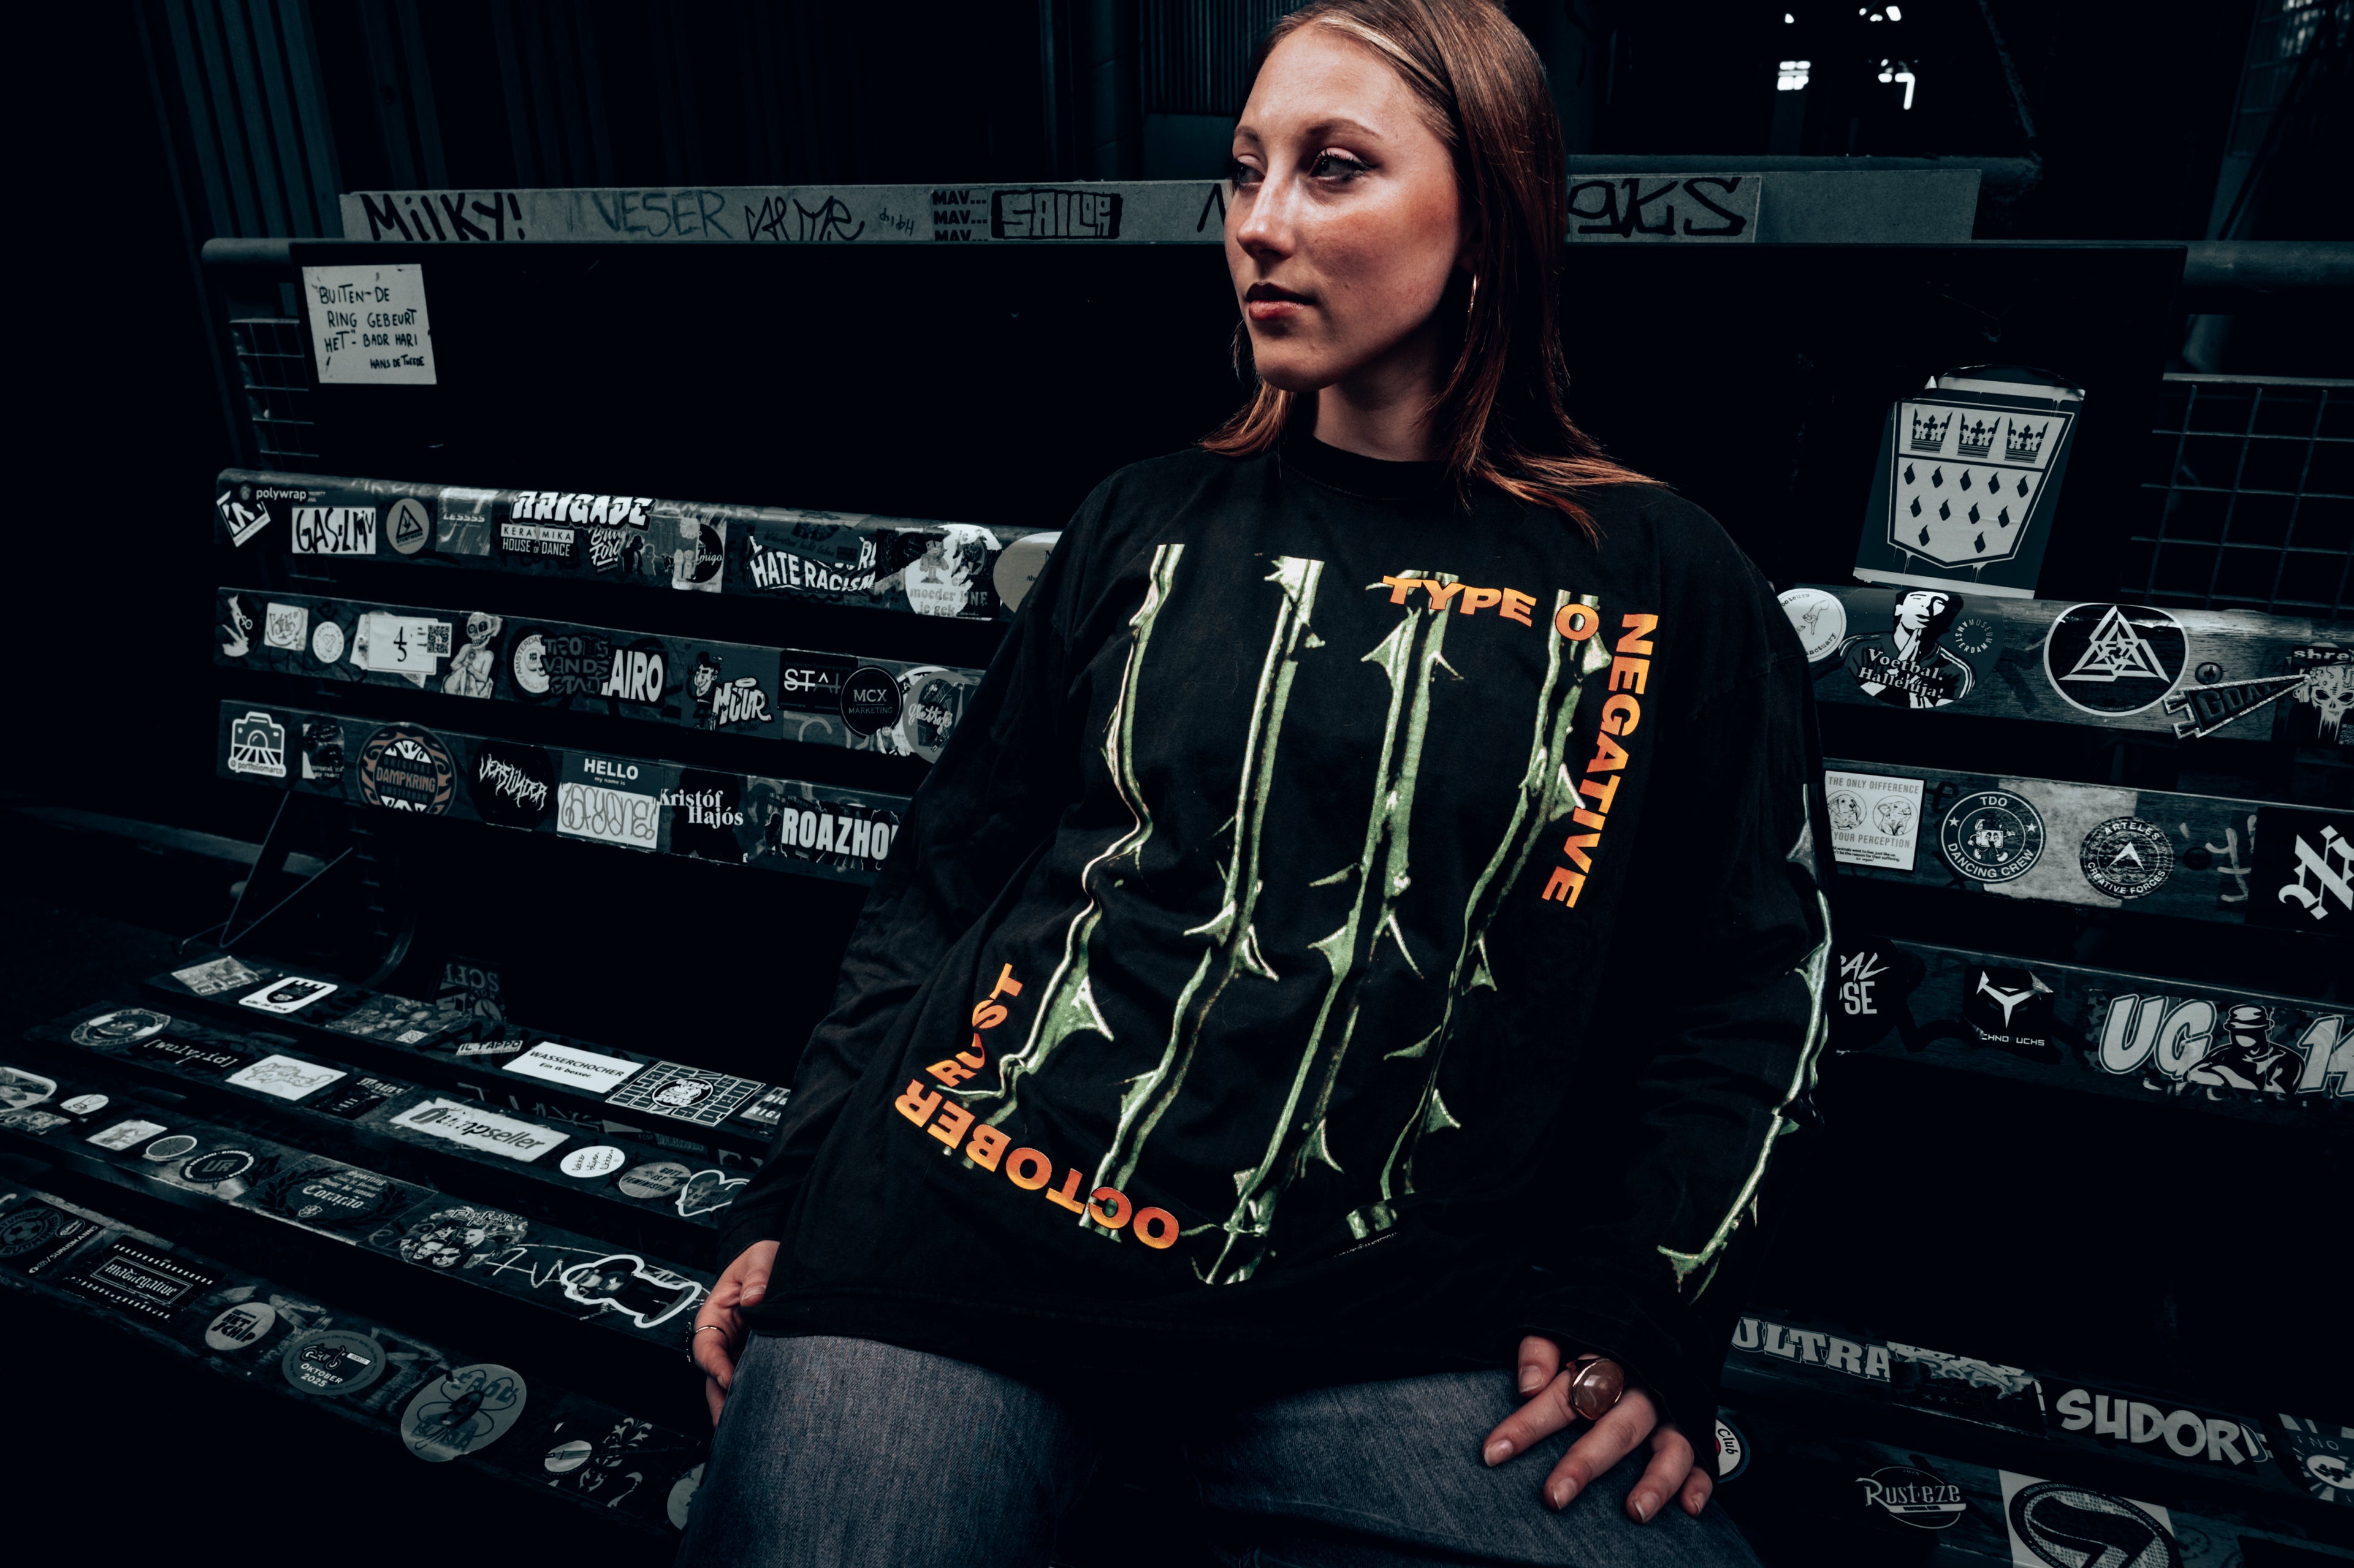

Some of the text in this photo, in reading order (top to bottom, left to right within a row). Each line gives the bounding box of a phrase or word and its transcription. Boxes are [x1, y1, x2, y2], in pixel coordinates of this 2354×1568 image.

[327, 308, 417, 328] RING GEBEURT
[395, 333, 418, 348] HARI
[370, 359, 390, 369] HANS
[393, 359, 401, 367] DE
[256, 487, 307, 502] polywrap
[502, 538, 531, 553] HOUSE
[541, 542, 571, 557] DANCE
[750, 550, 801, 588] HATE
[804, 560, 876, 592] RACISM
[1868, 647, 1943, 682] Voetbal.
[1857, 666, 1945, 699] Halleluja!
[853, 689, 888, 702] MCX
[848, 706, 894, 715] MARKETING
[1382, 575, 1659, 910] TYPE O NEGATIVE
[584, 758, 639, 780] HELLO
[376, 766, 436, 793] DAMPKRING
[1829, 777, 1919, 795] THE ONLY DIFFERENCE
[658, 788, 723, 808] Kristóf
[1979, 796, 2008, 807] TDO
[687, 806, 744, 829] Hajós
[1834, 831, 1913, 850] YOUR PERCEPTION.
[2103, 820, 2160, 842] ARTELES
[1947, 842, 2035, 878] DANCING CREW
[2087, 861, 2166, 896] CREATIVE FORCES
[894, 962, 1180, 1250] OCTOBER RUST
[660, 1166, 684, 1177] GOTT
[623, 1176, 671, 1193] FEMINISTIN
[300, 1363, 344, 1384] OKTOBER
[300, 1372, 329, 1388] 2025
[1716, 1427, 1739, 1456] Club
